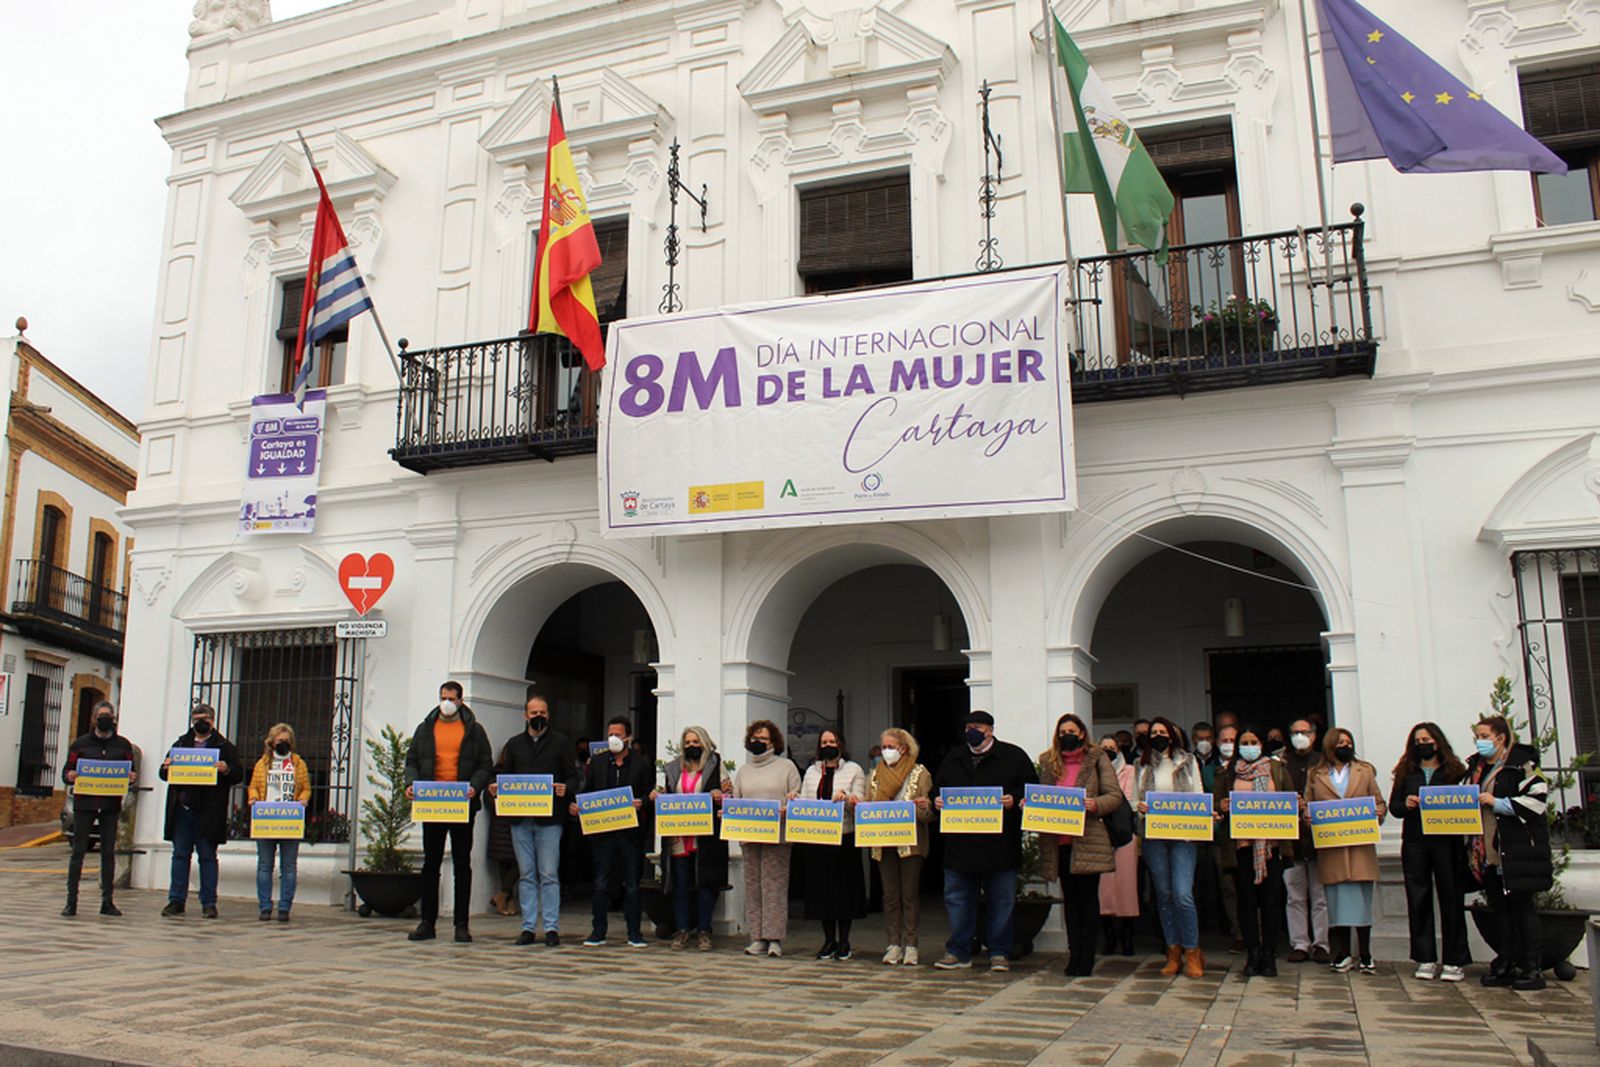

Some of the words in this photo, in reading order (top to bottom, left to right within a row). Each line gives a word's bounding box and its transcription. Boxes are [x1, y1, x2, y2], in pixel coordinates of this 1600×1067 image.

[757, 337, 799, 367] DÍA
[810, 316, 1045, 361] INTERNACIONAL
[619, 347, 741, 417] 8M
[757, 370, 806, 405] DE
[822, 364, 875, 398] LA
[889, 349, 1046, 392] MUJER
[843, 396, 1048, 473] Cartaya
[261, 441, 294, 450] Cartaya
[260, 449, 306, 460] IGUALDAD
[649, 501, 676, 510] Cartaya
[172, 754, 214, 762] CARTAYA
[82, 766, 126, 774] CARTAYA
[502, 782, 548, 791] CARTAYA
[418, 789, 464, 798] CARTAYA
[582, 795, 628, 810] CARTAYA
[947, 796, 997, 806] CARTAYA
[1030, 794, 1080, 806] CARTAYA
[1424, 794, 1474, 804] CARTAYA
[661, 801, 706, 810] CARTAYA
[1152, 800, 1207, 811] CARTAYA
[1236, 800, 1292, 810] CARTAYA
[256, 808, 299, 817] CARTAYA
[728, 806, 774, 817] CARTAYA
[792, 808, 838, 818] CARTAYA
[861, 810, 910, 819] CARTAYA
[1316, 806, 1371, 820] CARTAYA
[586, 818, 600, 826] CON
[602, 814, 632, 823] UCRANIA
[660, 820, 676, 828] CON
[964, 816, 998, 824] UCRANIA
[1028, 814, 1044, 822] CON
[1046, 816, 1080, 826] UCRANIA
[744, 826, 775, 834] UCRANIA
[790, 826, 806, 834] CON
[807, 828, 838, 836] UCRANIA
[1151, 822, 1170, 830] CON
[1172, 822, 1208, 831] UCRANIA
[1236, 822, 1254, 830] CON
[1256, 822, 1294, 830] UCRANIA
[860, 830, 877, 838] CON
[1338, 828, 1374, 836] UCRANIA
